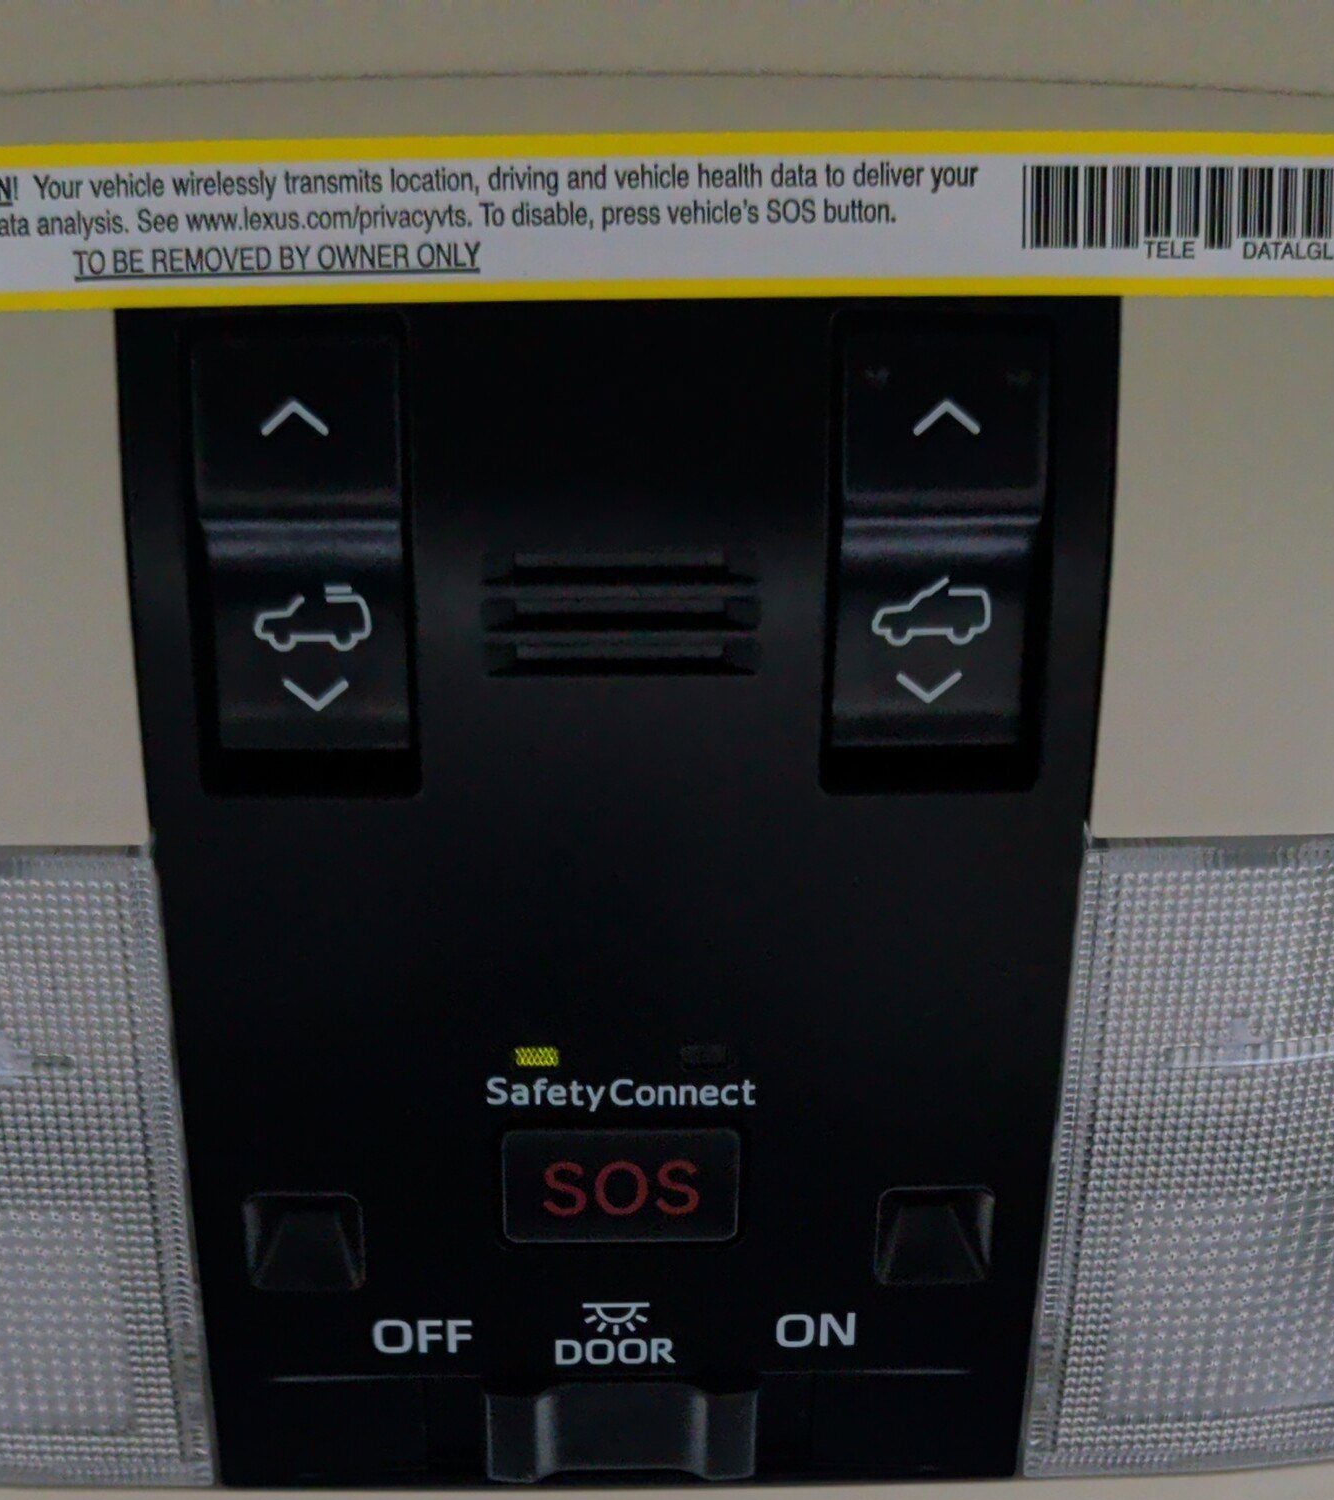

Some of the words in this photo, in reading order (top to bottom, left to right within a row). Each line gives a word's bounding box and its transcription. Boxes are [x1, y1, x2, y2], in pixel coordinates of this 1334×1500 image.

[33, 174, 83, 201] Your
[90, 172, 165, 199] vehicle
[172, 169, 277, 201] wirelessly
[284, 168, 383, 195] transmits
[390, 166, 480, 196] location,
[488, 165, 559, 197] driving
[567, 164, 607, 191] and
[614, 163, 689, 190] vehicle
[697, 162, 763, 188] health
[771, 162, 817, 188] data
[825, 163, 845, 188] to
[852, 161, 925, 188] deliver
[930, 165, 979, 195] your
[37, 208, 129, 242] analysis.
[137, 207, 178, 234] See
[185, 202, 473, 235] www.lexus.com/privacyvts.
[479, 201, 505, 228] To
[512, 200, 594, 230] disable,
[601, 204, 661, 232] press
[667, 197, 759, 226] vehicle's
[766, 198, 816, 225] SOS
[823, 198, 897, 225] button.
[72, 250, 105, 276] TO
[113, 249, 144, 275] BE
[151, 246, 271, 274] REMOVED
[279, 244, 311, 271] BY
[317, 243, 410, 271] OWNER
[417, 240, 482, 269] ONLY
[1144, 239, 1195, 260] TELE
[1242, 240, 1334, 261] DATALGL
[542, 1160, 701, 1217] SOS
[372, 1319, 473, 1354] OFF
[554, 1338, 676, 1366] DOOR
[776, 1312, 858, 1348] ON
